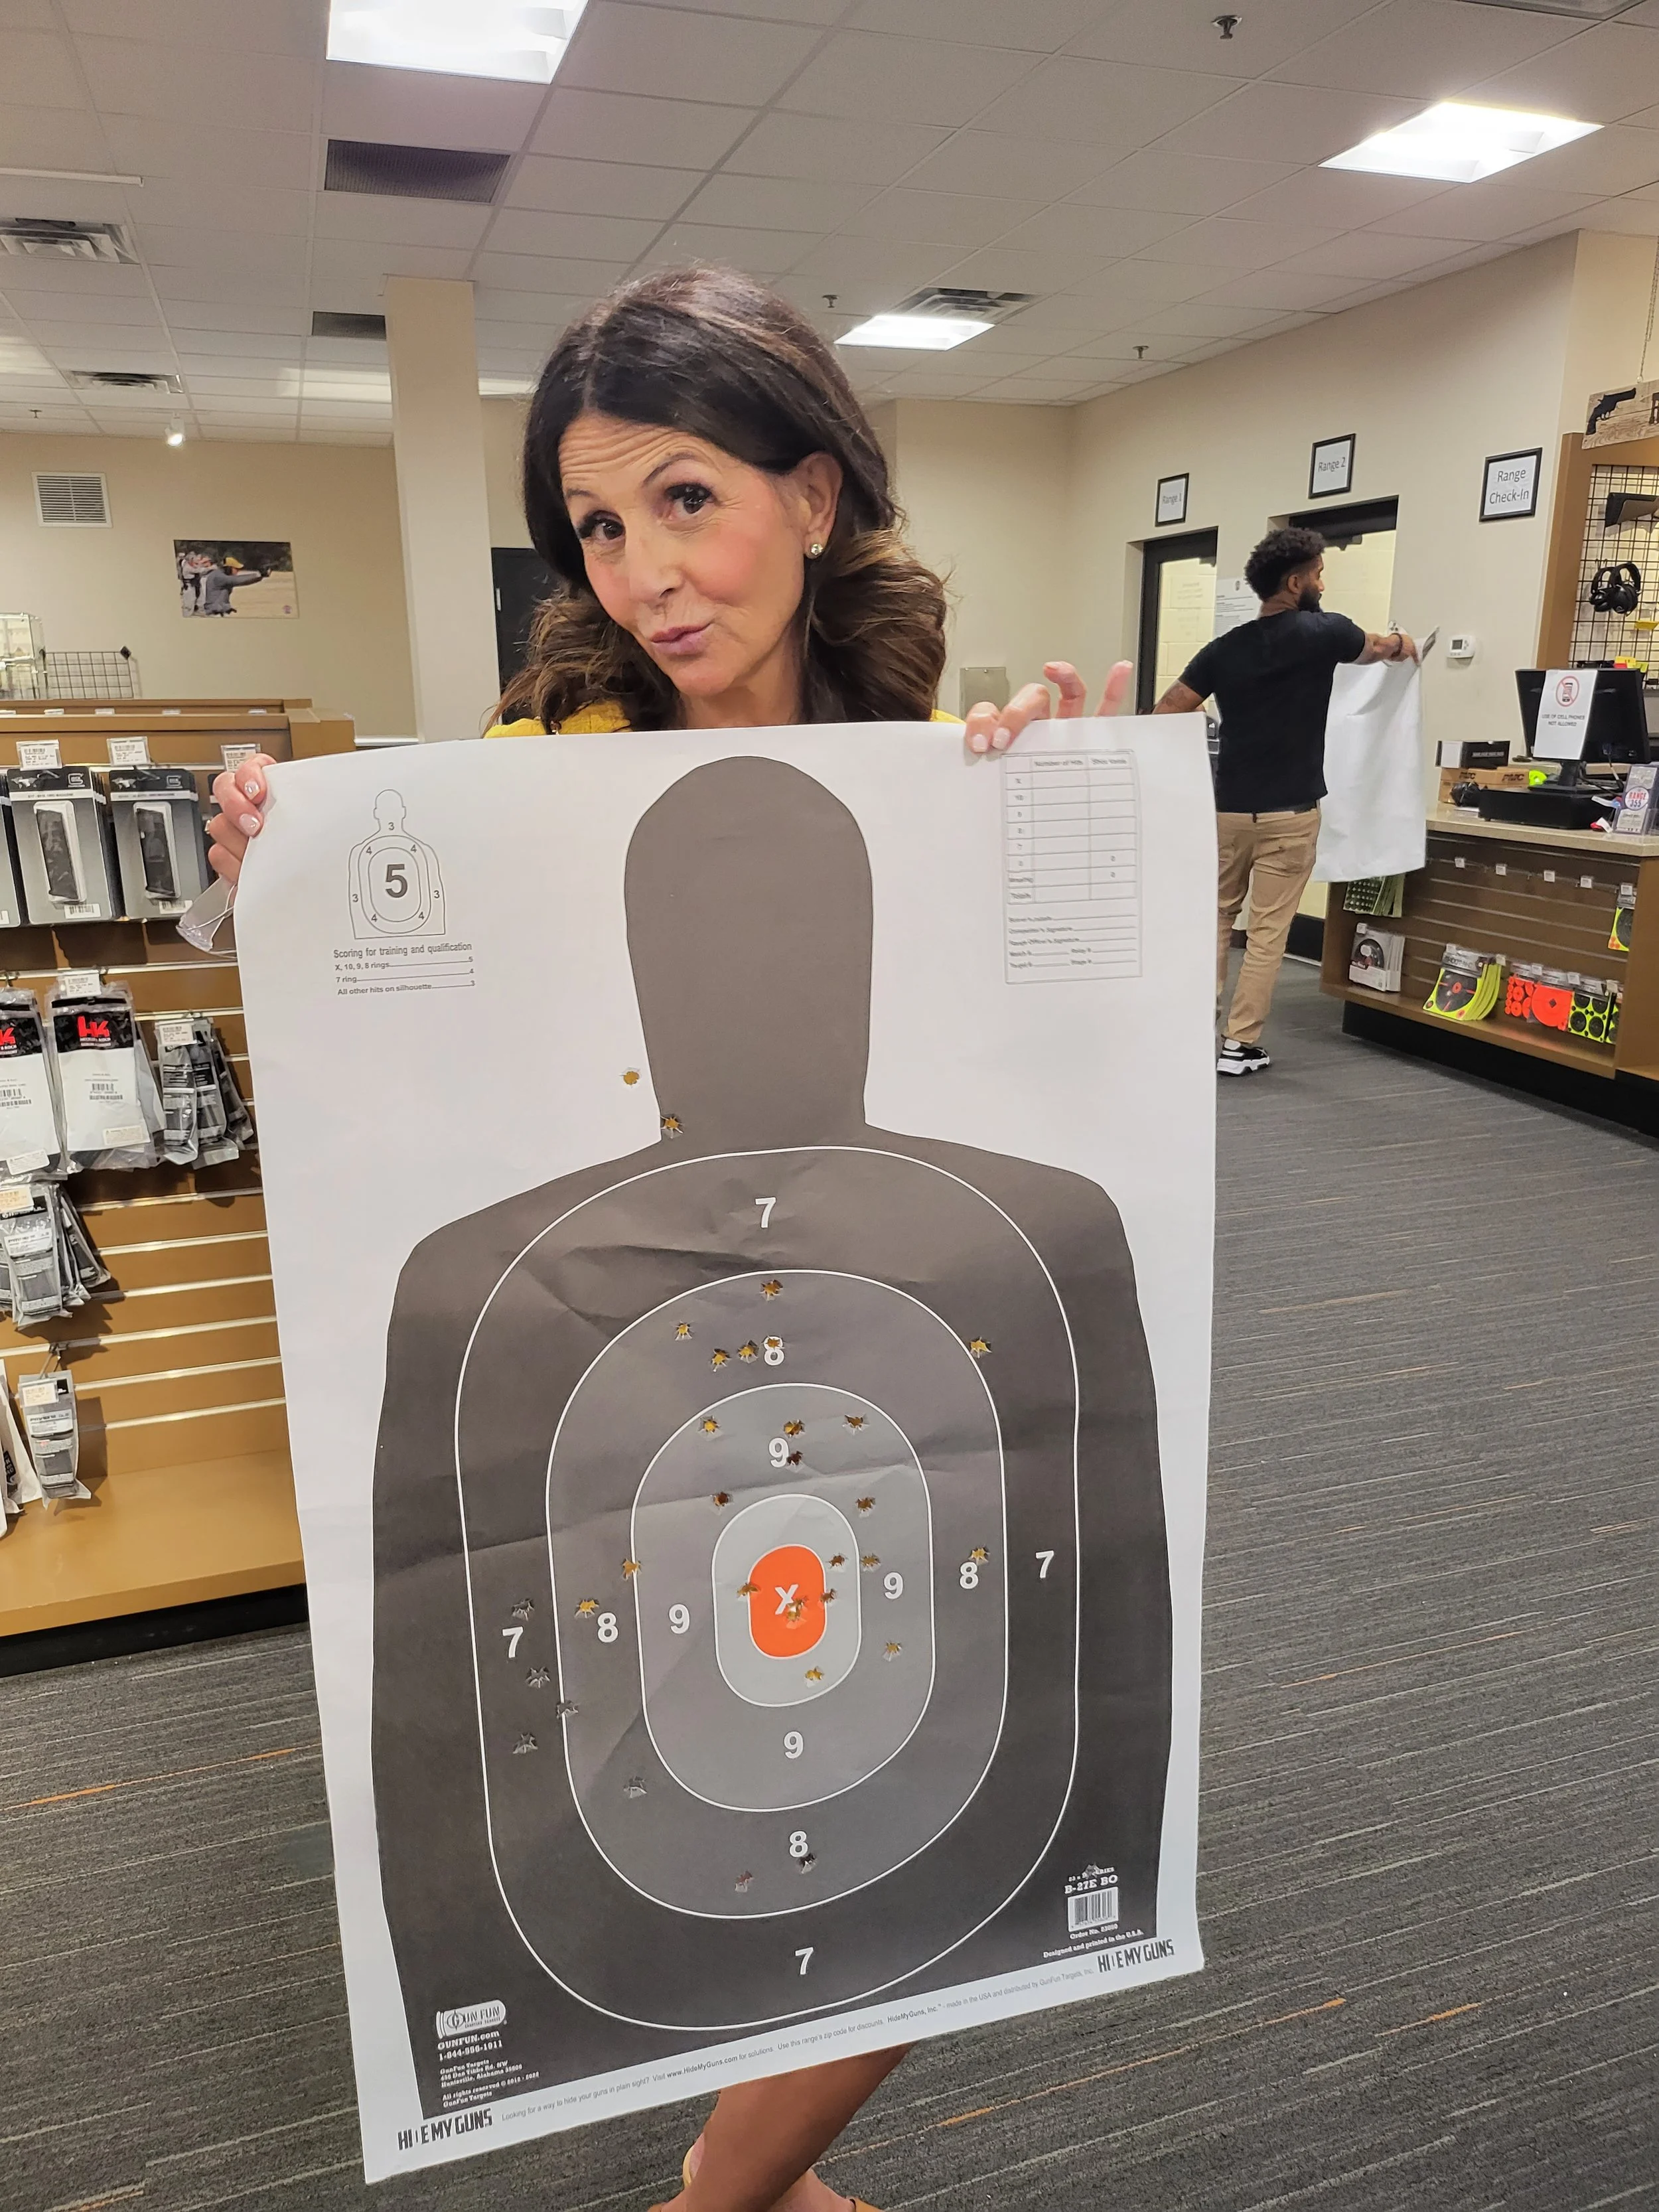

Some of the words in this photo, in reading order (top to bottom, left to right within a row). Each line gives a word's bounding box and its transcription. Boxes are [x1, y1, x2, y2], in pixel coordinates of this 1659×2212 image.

[1318, 460, 1339, 473] Range
[1341, 457, 1346, 468] 2
[1497, 469, 1526, 482] Range
[1162, 496, 1179, 504] Range
[1489, 488, 1530, 504] Check-In
[388, 822, 395, 831] 3
[366, 846, 373, 855] 4
[411, 844, 417, 853] 4
[386, 863, 408, 899] 5
[352, 894, 359, 903] 3
[433, 890, 441, 899] 3
[371, 914, 378, 922] 4
[418, 911, 425, 921] 4
[334, 949, 363, 959] Scoring
[366, 948, 376, 956] for
[379, 946, 408, 957] training
[411, 944, 425, 954] and
[427, 942, 472, 954] qualification
[371, 961, 390, 970] rings
[755, 1197, 778, 1229] 7
[763, 1335, 784, 1366] 8
[768, 1438, 790, 1469] 9
[1035, 1550, 1056, 1579] 7
[883, 1572, 904, 1600] 9
[960, 1562, 979, 1591] 8
[774, 1584, 800, 1616] X
[598, 1613, 620, 1643] 8
[670, 1603, 691, 1634] 9
[502, 1627, 525, 1659] 7
[784, 1731, 805, 1759] 9
[788, 1830, 810, 1858] 8
[1064, 1880, 1098, 1895] B-27E
[1100, 1874, 1118, 1886] BO
[1043, 1947, 1073, 1958] Designed
[1073, 1943, 1085, 1952] and
[1085, 1938, 1108, 1950] printed
[1116, 1933, 1125, 1941] the
[795, 1947, 816, 1976] 7
[502, 2108, 526, 2122] Looking
[527, 2105, 536, 2114] for
[542, 2102, 555, 2113] way
[563, 2095, 577, 2106] hide
[577, 2093, 592, 2104] your
[593, 2089, 609, 2101] guns
[616, 2081, 630, 2094] plain
[632, 2077, 650, 2091] sight?
[652, 2073, 666, 2083] Visit
[666, 2055, 738, 2079] www.HideMyGuns.com
[748, 2046, 774, 2059] solutions.
[777, 2040, 789, 2051] Use
[790, 2037, 801, 2046] this
[801, 2033, 823, 2045] range's
[823, 2031, 832, 2041] zip
[833, 2028, 847, 2037] code
[847, 2024, 856, 2033] for
[856, 2018, 884, 2031] discounts.
[887, 2009, 926, 2024] HideMyGuns,
[946, 1998, 962, 2009] made
[969, 1994, 978, 2003] the
[978, 1992, 992, 2001] USA
[992, 1989, 1003, 1998] and
[1003, 1981, 1031, 1996] distributed
[1032, 1980, 1039, 1989] by
[1039, 1974, 1062, 1986] GunFun
[1062, 1968, 1083, 1983] Targets,
[440, 2064, 465, 2075] GunFun
[466, 2059, 490, 2069] Targets
[441, 2077, 475, 2089] Huntsville,
[476, 2069, 504, 2079] Alabama
[443, 2097, 469, 2108] GunFun
[469, 2091, 493, 2102] Targets
[453, 2089, 471, 2098] rights
[472, 2082, 500, 2093] reserved
